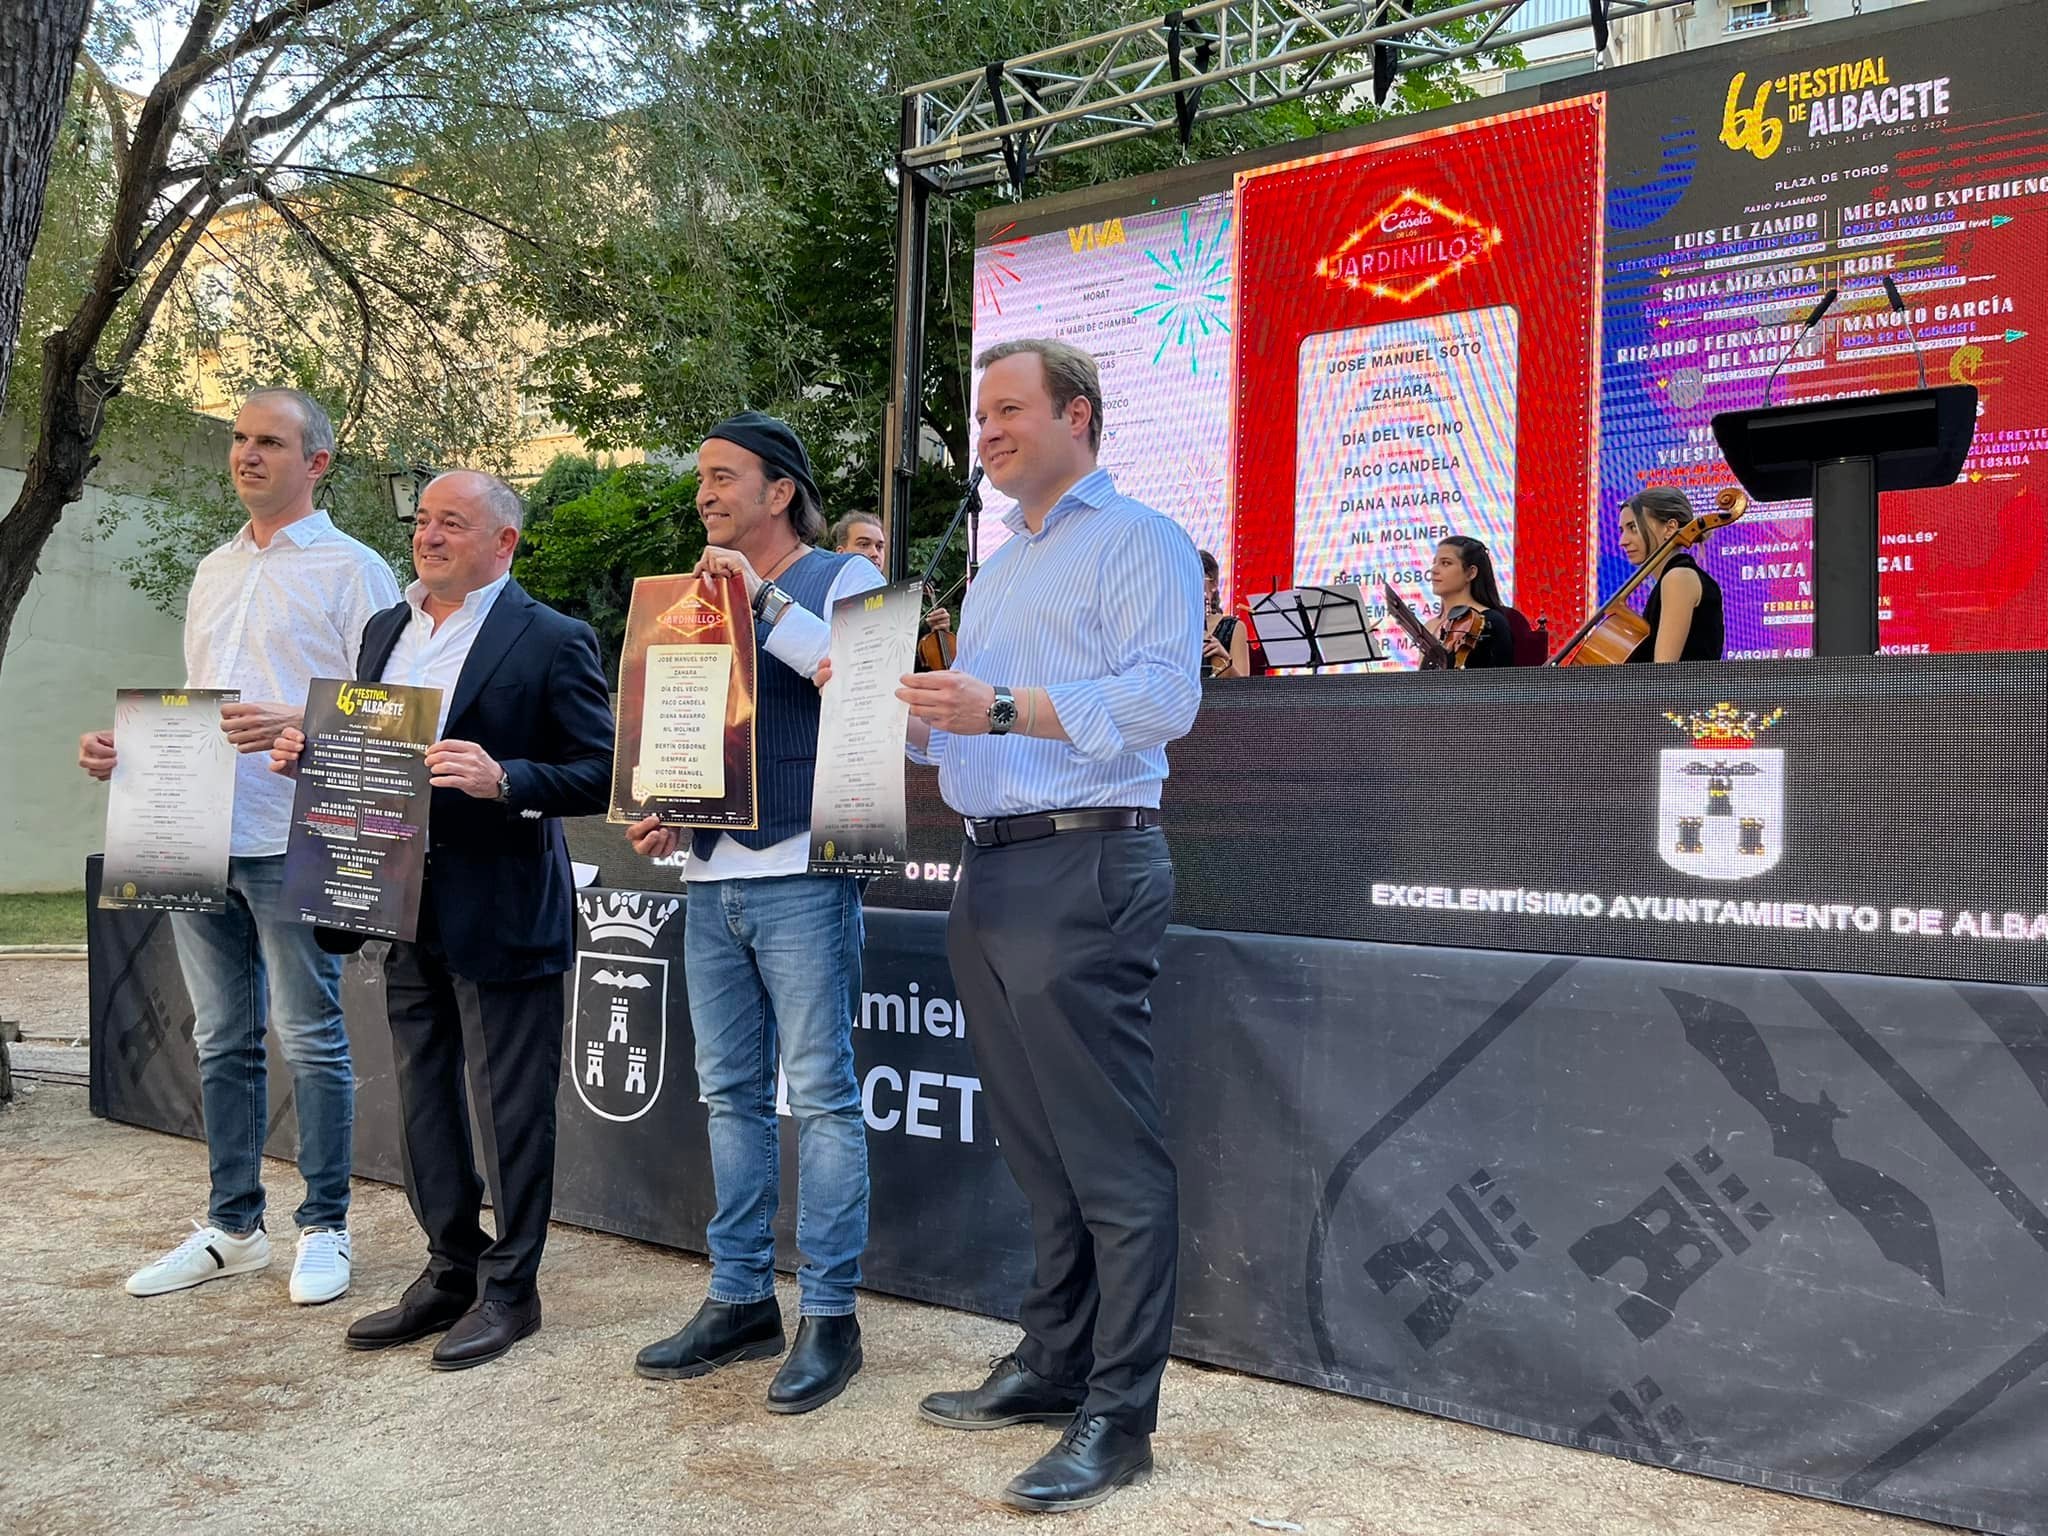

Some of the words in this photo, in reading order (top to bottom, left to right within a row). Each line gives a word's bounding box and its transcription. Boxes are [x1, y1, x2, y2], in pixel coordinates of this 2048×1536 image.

[1789, 56, 1890, 101] FESTIVAL
[1789, 104, 1806, 123] DE
[1809, 77, 1950, 137] ALBACETE
[1775, 176, 1816, 191] PLAZA
[1821, 173, 1838, 183] DE
[1845, 164, 1889, 179] TOROS
[1774, 194, 1827, 208] FLAMENCO
[1844, 194, 1927, 221] MECANO
[1934, 176, 2048, 208] EXPERIENC
[1381, 209, 1433, 232] Caseta
[1675, 229, 1716, 250] LUIS
[1722, 226, 1743, 242] EL
[1750, 213, 1818, 237] ZAMBO
[1067, 217, 1127, 254] VIVA
[1334, 233, 1482, 279] JARDINILLOS
[1844, 254, 1896, 275] ROBE
[1662, 281, 1719, 301] SONIA
[1725, 265, 1817, 291] MIRANDA
[1083, 289, 1110, 301] MORAT
[1844, 308, 1927, 332] MANOLO
[1935, 295, 2013, 321] GARCÍA
[1056, 328, 1064, 337] LA
[1067, 325, 1084, 335] MARI
[1087, 323, 1096, 332] DE
[1098, 316, 1137, 330] CHAMBAO
[1617, 340, 1697, 363] RICARDO
[1704, 323, 1816, 351] FERNÁNDEZ
[1329, 355, 1365, 374] JOSÉ
[1371, 348, 1433, 369] MANUEL
[1440, 342, 1482, 359] SOTO
[1708, 351, 1740, 369] DEL
[1749, 343, 1817, 364] MORAL
[1372, 384, 1433, 402] ZAHARA
[1343, 430, 1366, 446] DÍA
[1373, 429, 1400, 442] DEL
[1407, 421, 1463, 439] VECINO
[1344, 464, 1382, 479] PACO
[1389, 456, 1460, 474] CANDELA
[1341, 497, 1385, 512] DIANA
[1391, 490, 1462, 508] NAVARRO
[1352, 532, 1374, 545] NIL
[1381, 526, 1449, 542] MOLINER
[1721, 542, 1798, 556] EXPLANADA
[1741, 562, 1806, 581] DANZA
[865, 594, 884, 612] VIVA
[663, 614, 721, 625] JARDINILLOS
[658, 655, 673, 663] JOSÉ
[1727, 648, 1778, 660] PARQUE
[1879, 643, 1930, 655] NCHEZ
[162, 695, 189, 706] VIVA
[358, 688, 388, 701] FESTIVAL
[361, 701, 404, 716] ALBACETE
[924, 863, 950, 881] DE
[1370, 883, 1599, 918] EXCELENTÍSIMO
[1608, 894, 1879, 934] AYUNTAMIENTO
[1891, 908, 1944, 936] DE
[853, 982, 965, 1038] mie
